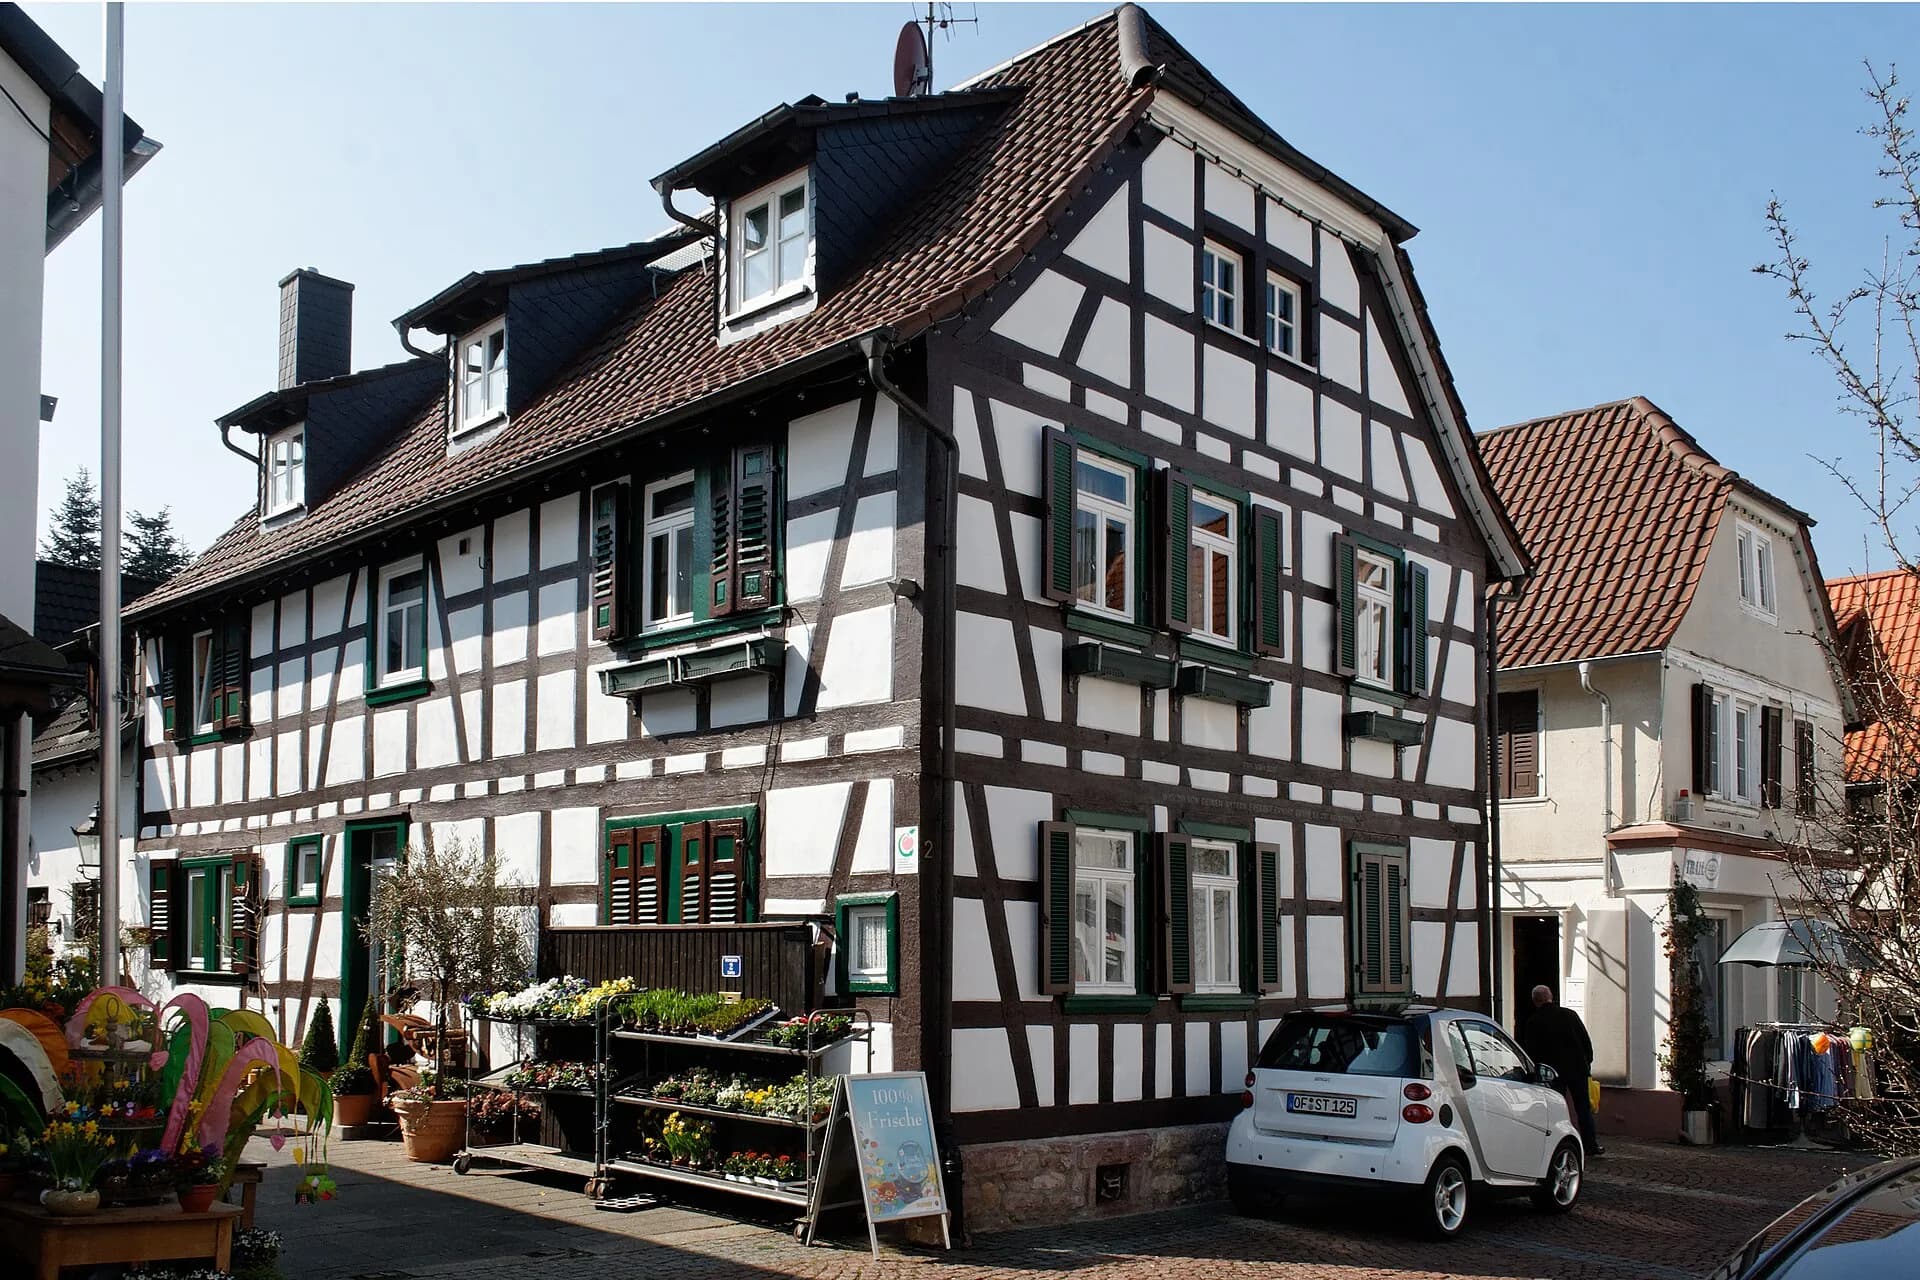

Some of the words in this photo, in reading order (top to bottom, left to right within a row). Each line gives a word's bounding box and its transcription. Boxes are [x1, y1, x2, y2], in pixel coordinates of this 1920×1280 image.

[924, 840, 933, 858] 2
[872, 1088, 913, 1105] 100%
[1294, 1096, 1307, 1109] OF
[1315, 1098, 1330, 1111] ST
[1332, 1100, 1354, 1113] 125
[867, 1107, 923, 1129] Frische
